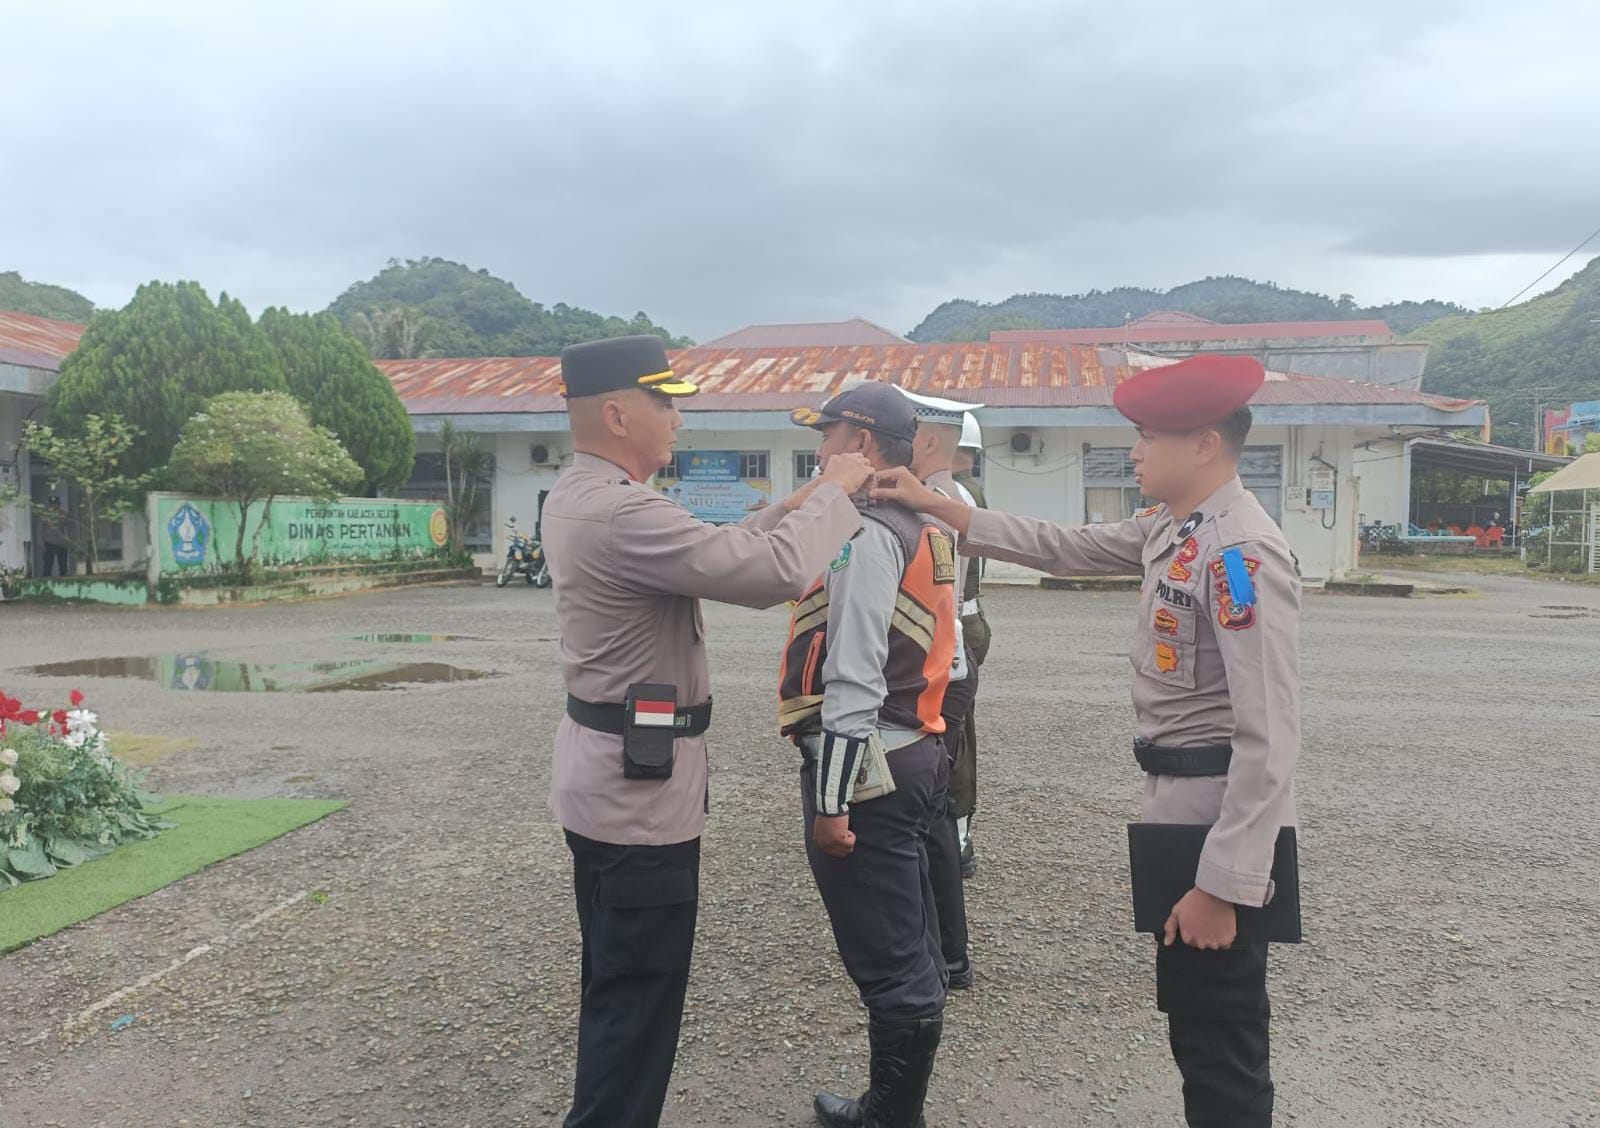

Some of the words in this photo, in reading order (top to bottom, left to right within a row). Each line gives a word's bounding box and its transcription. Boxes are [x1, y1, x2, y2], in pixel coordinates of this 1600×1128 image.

[376, 509, 399, 519] SELAT
[288, 523, 335, 540] DINAS
[1155, 579, 1192, 607] POLRI
